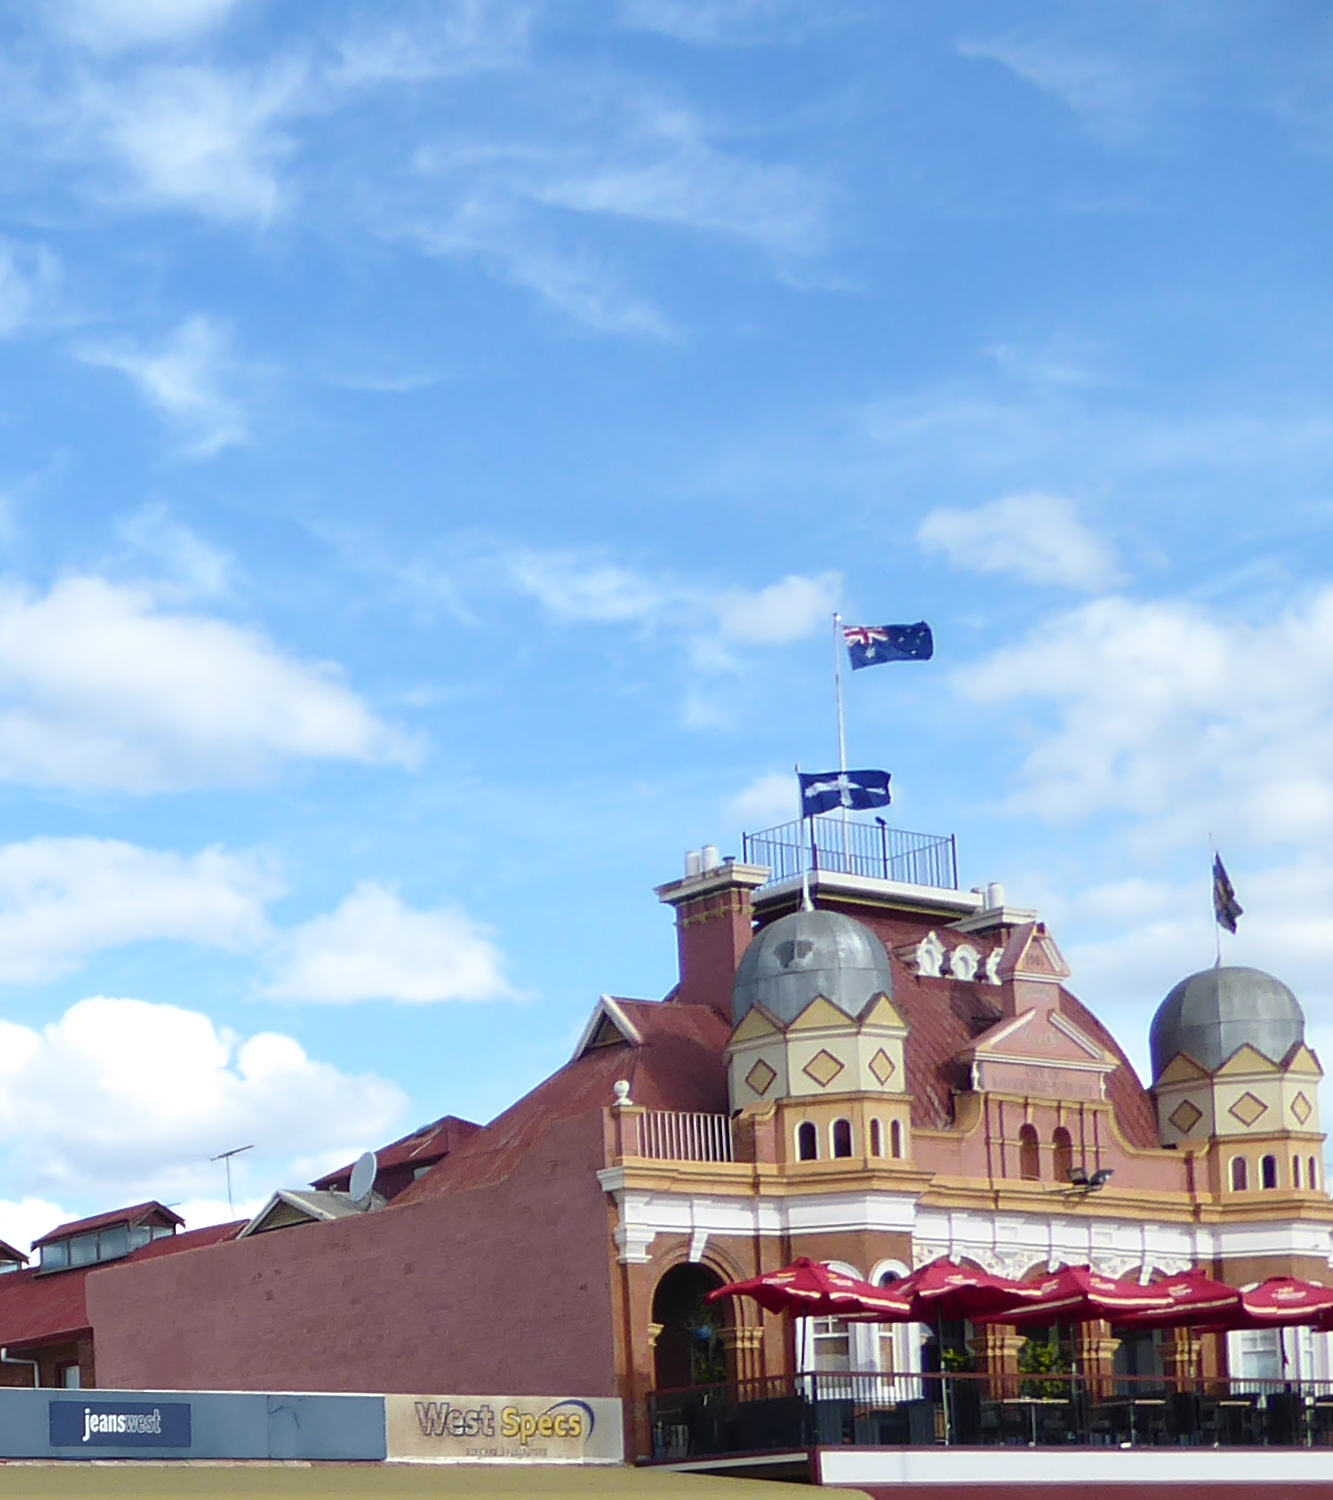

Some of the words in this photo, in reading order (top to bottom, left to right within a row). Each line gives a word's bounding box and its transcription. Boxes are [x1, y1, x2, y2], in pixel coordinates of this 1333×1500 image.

[81, 1407, 162, 1442] jeanswest
[414, 1401, 495, 1437] West
[500, 1405, 583, 1445] Specs
